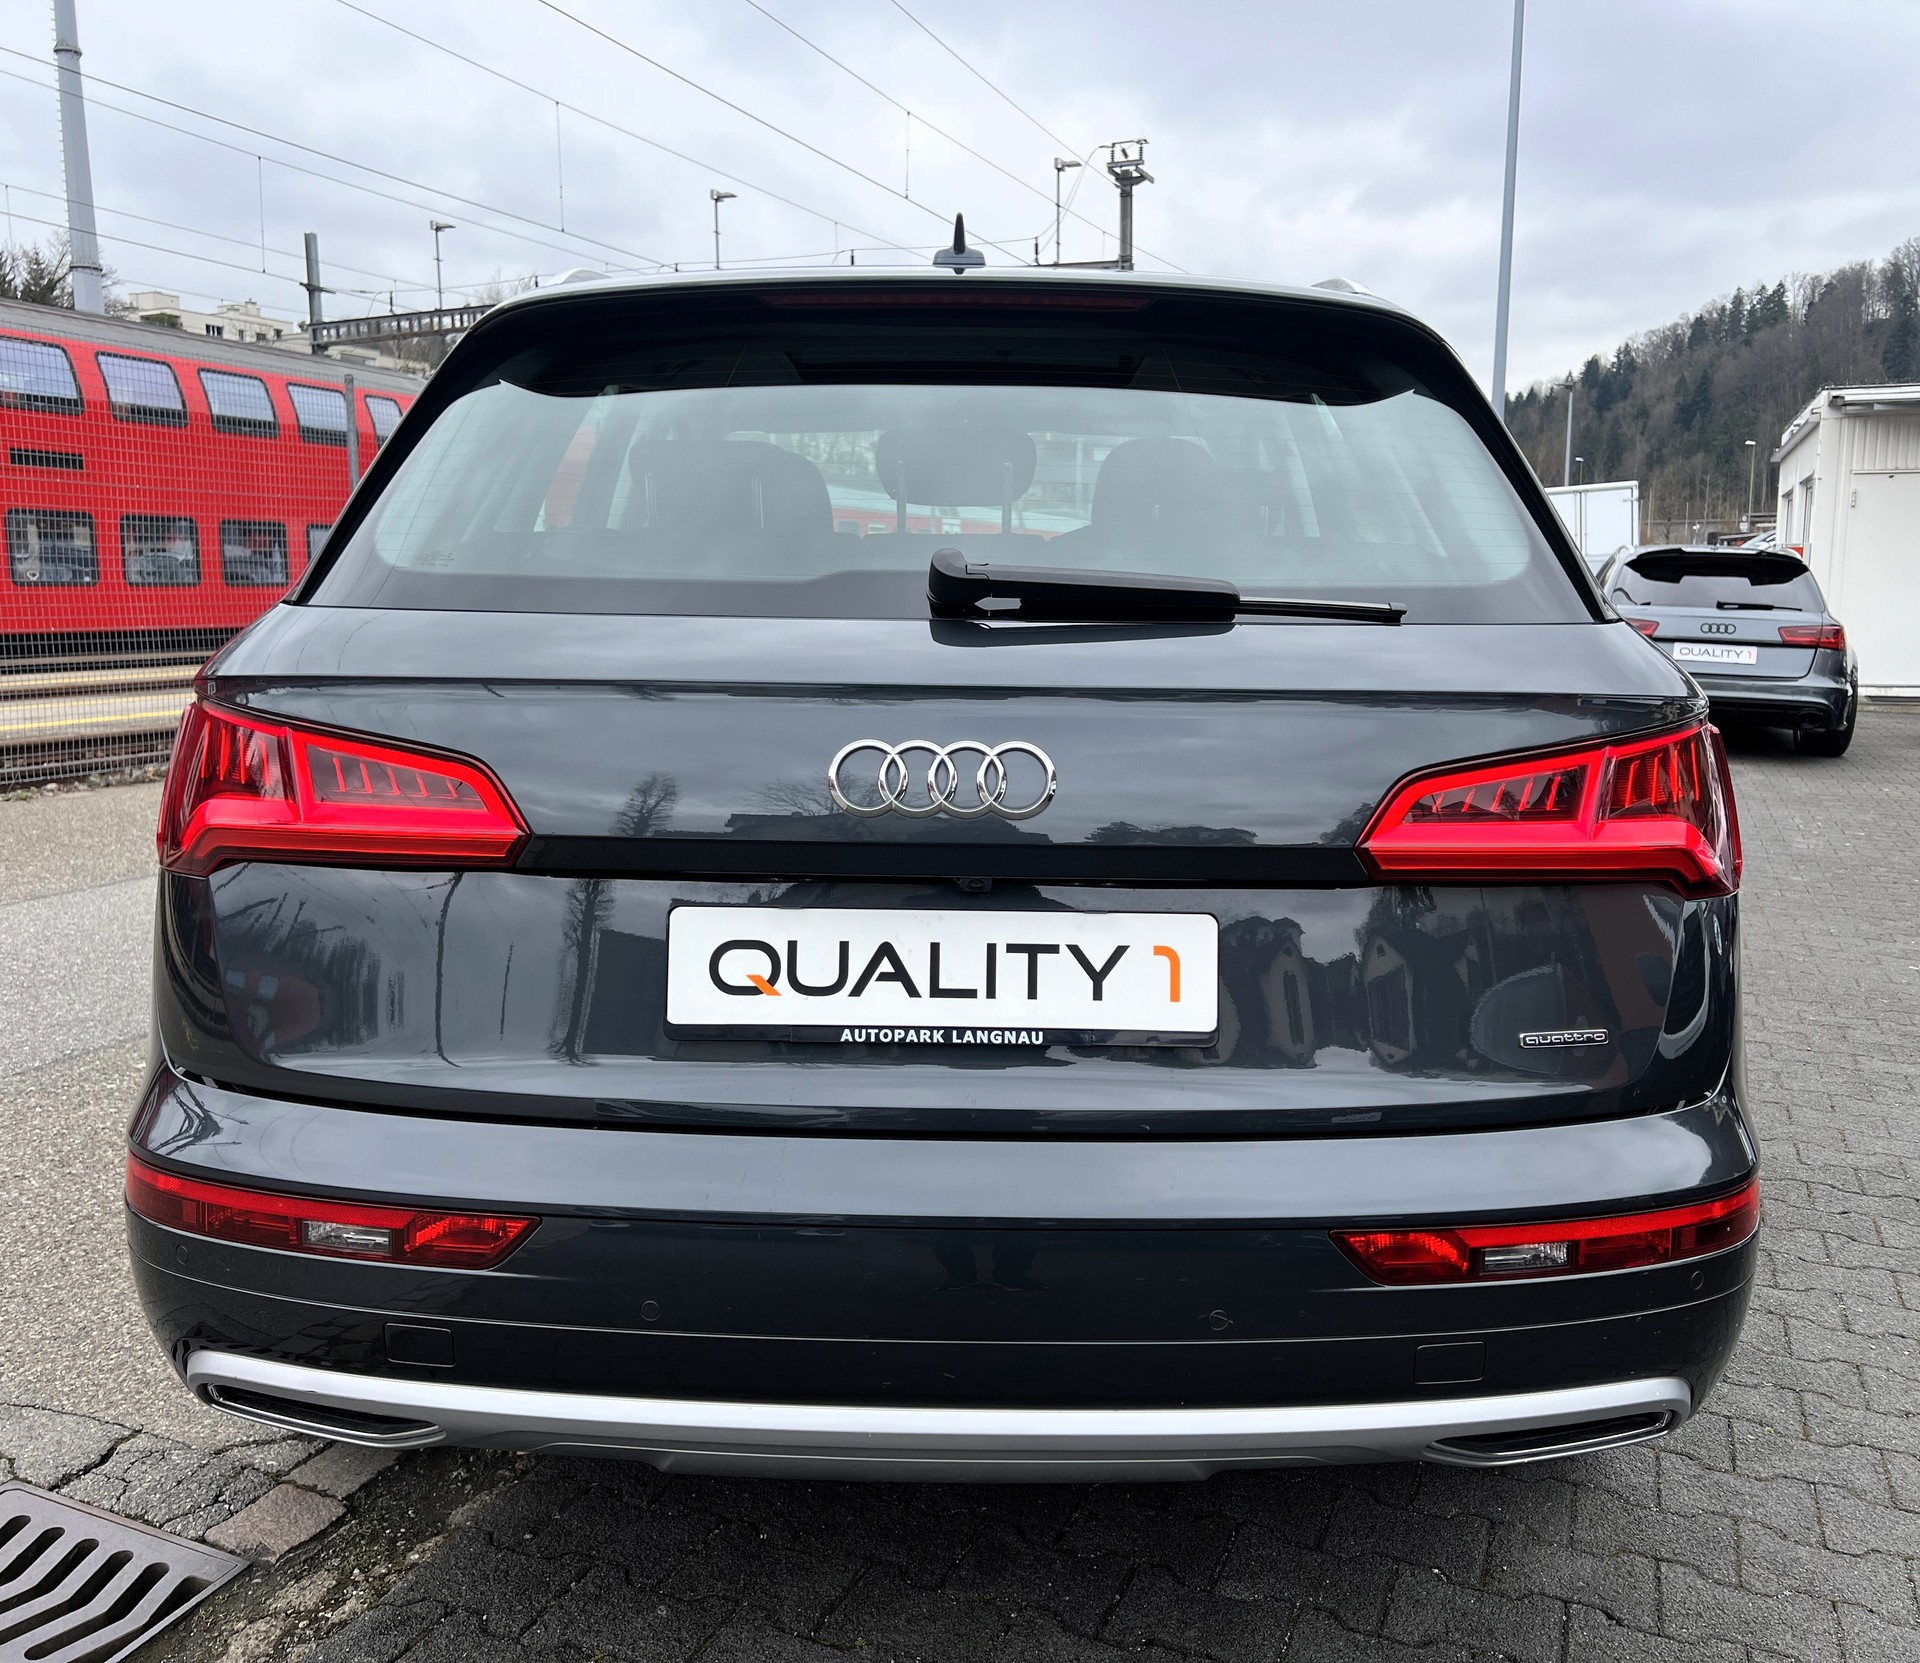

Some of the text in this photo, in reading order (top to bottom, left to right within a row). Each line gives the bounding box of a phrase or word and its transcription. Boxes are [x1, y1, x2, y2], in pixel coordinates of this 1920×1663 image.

[1679, 647, 1743, 659] QUALITY
[708, 939, 1181, 1003] QUALITY 1
[840, 1028, 1045, 1046] AUTOPARK LANGNAU
[1525, 1033, 1606, 1045] quattro
